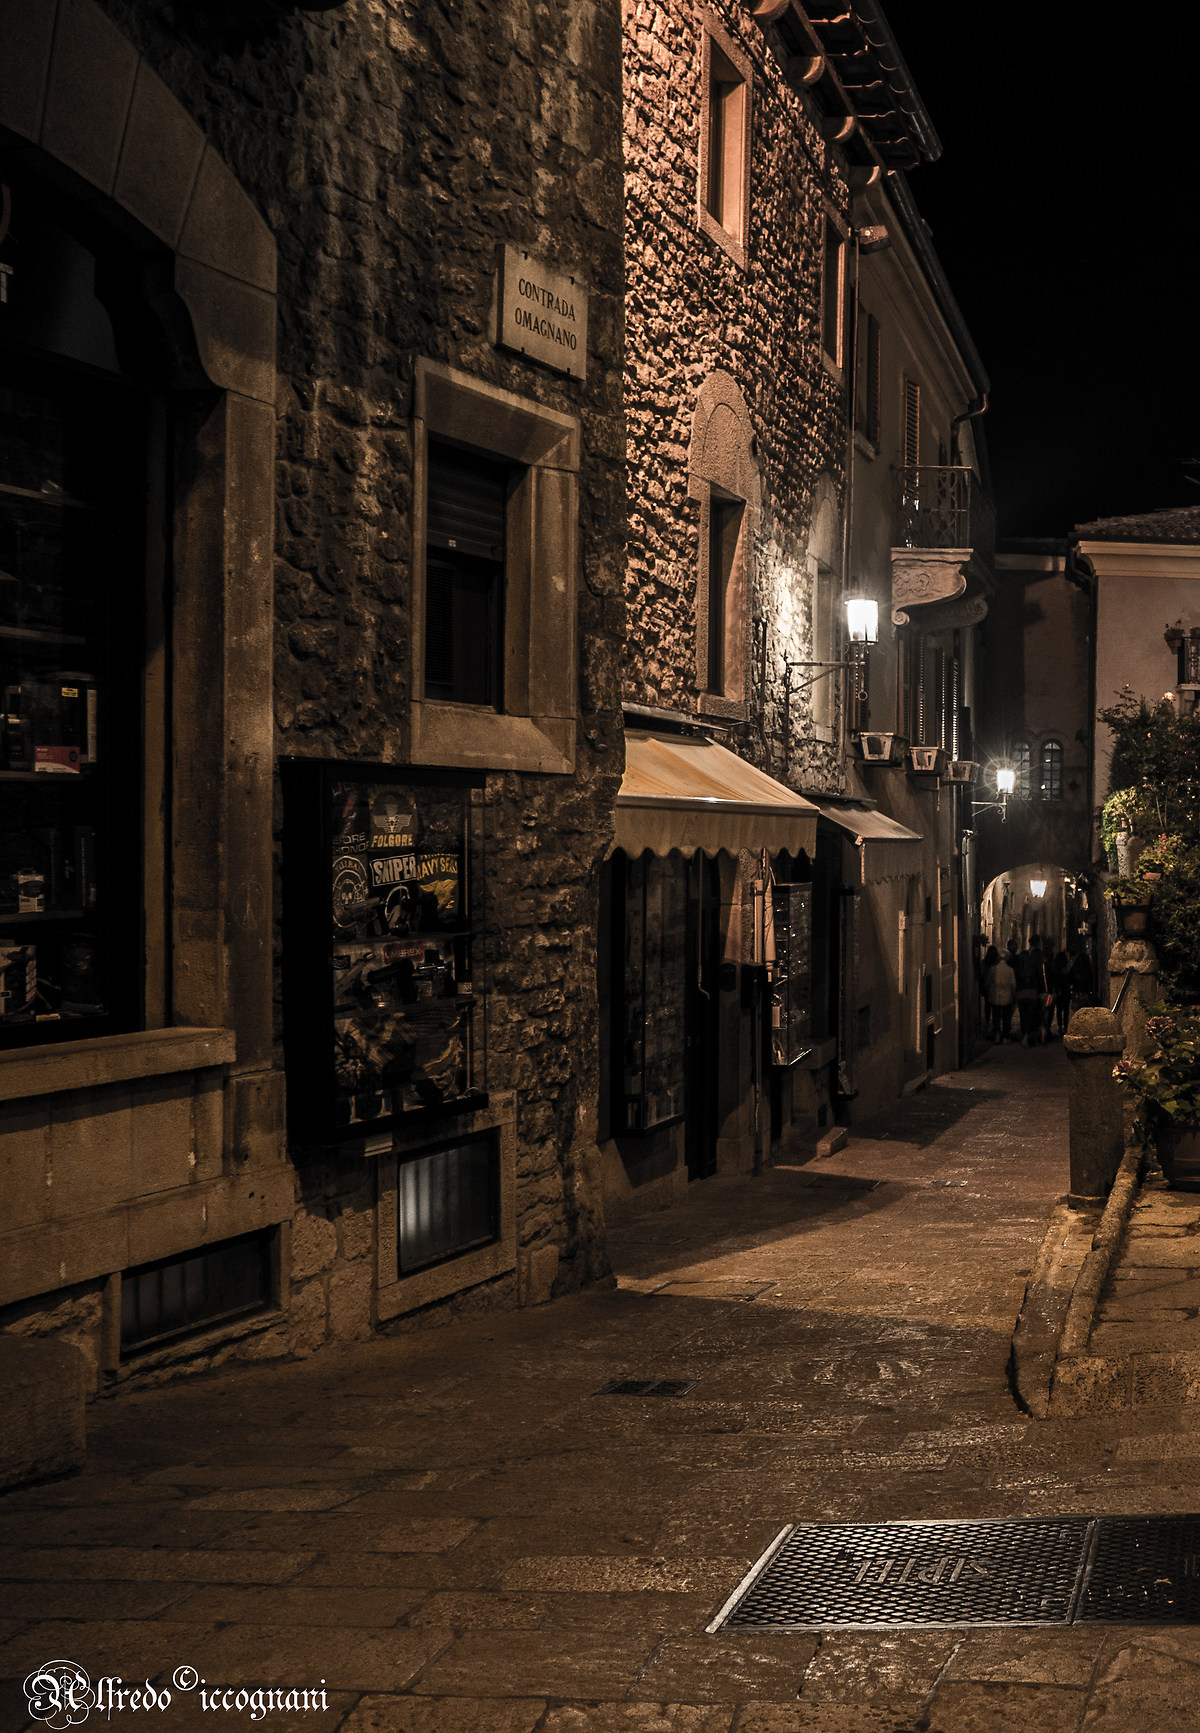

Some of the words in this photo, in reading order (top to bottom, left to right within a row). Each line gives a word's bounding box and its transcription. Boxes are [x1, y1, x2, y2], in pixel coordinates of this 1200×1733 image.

[518, 278, 576, 321] CONTRADA
[514, 307, 577, 350] OMAGNANO
[371, 834, 413, 848] FOLGORE
[373, 856, 417, 883] SNIPER
